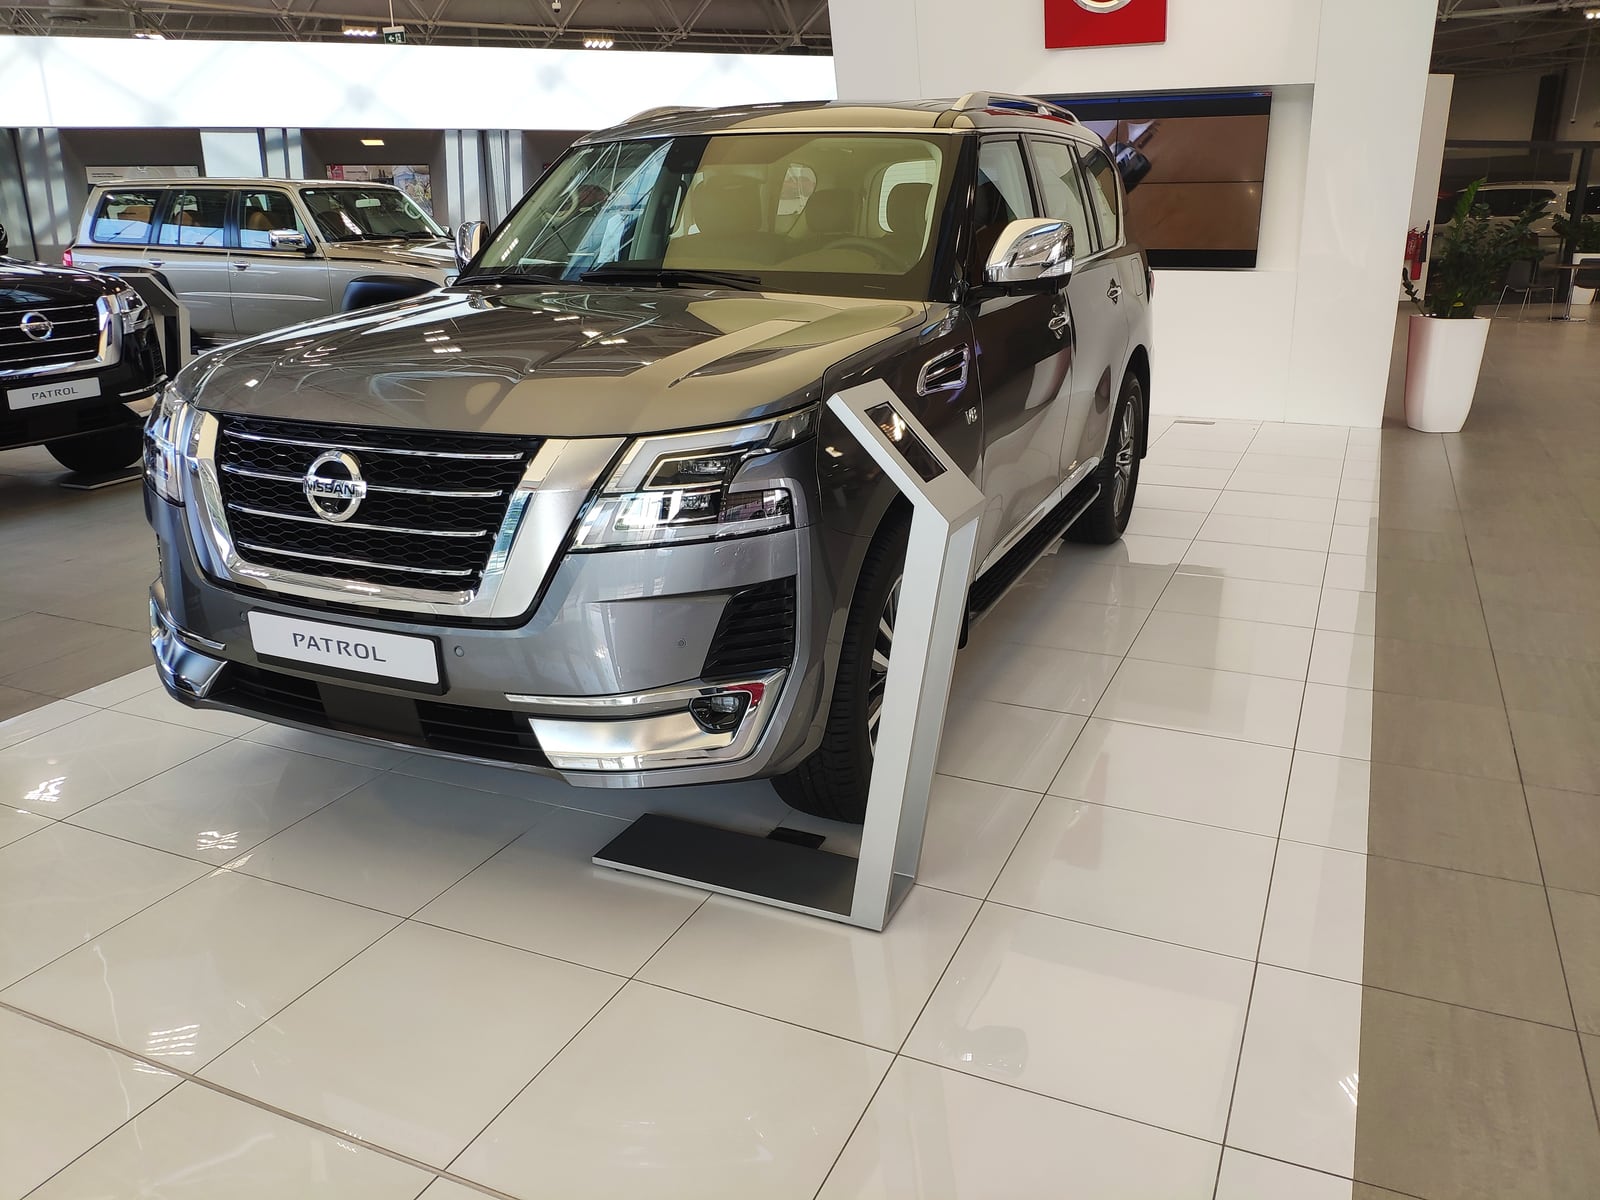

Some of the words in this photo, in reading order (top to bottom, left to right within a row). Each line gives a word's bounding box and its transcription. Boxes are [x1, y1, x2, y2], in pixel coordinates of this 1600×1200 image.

[31, 387, 78, 401] PATROL
[305, 479, 356, 495] NISSAN
[292, 632, 387, 663] PATROL
